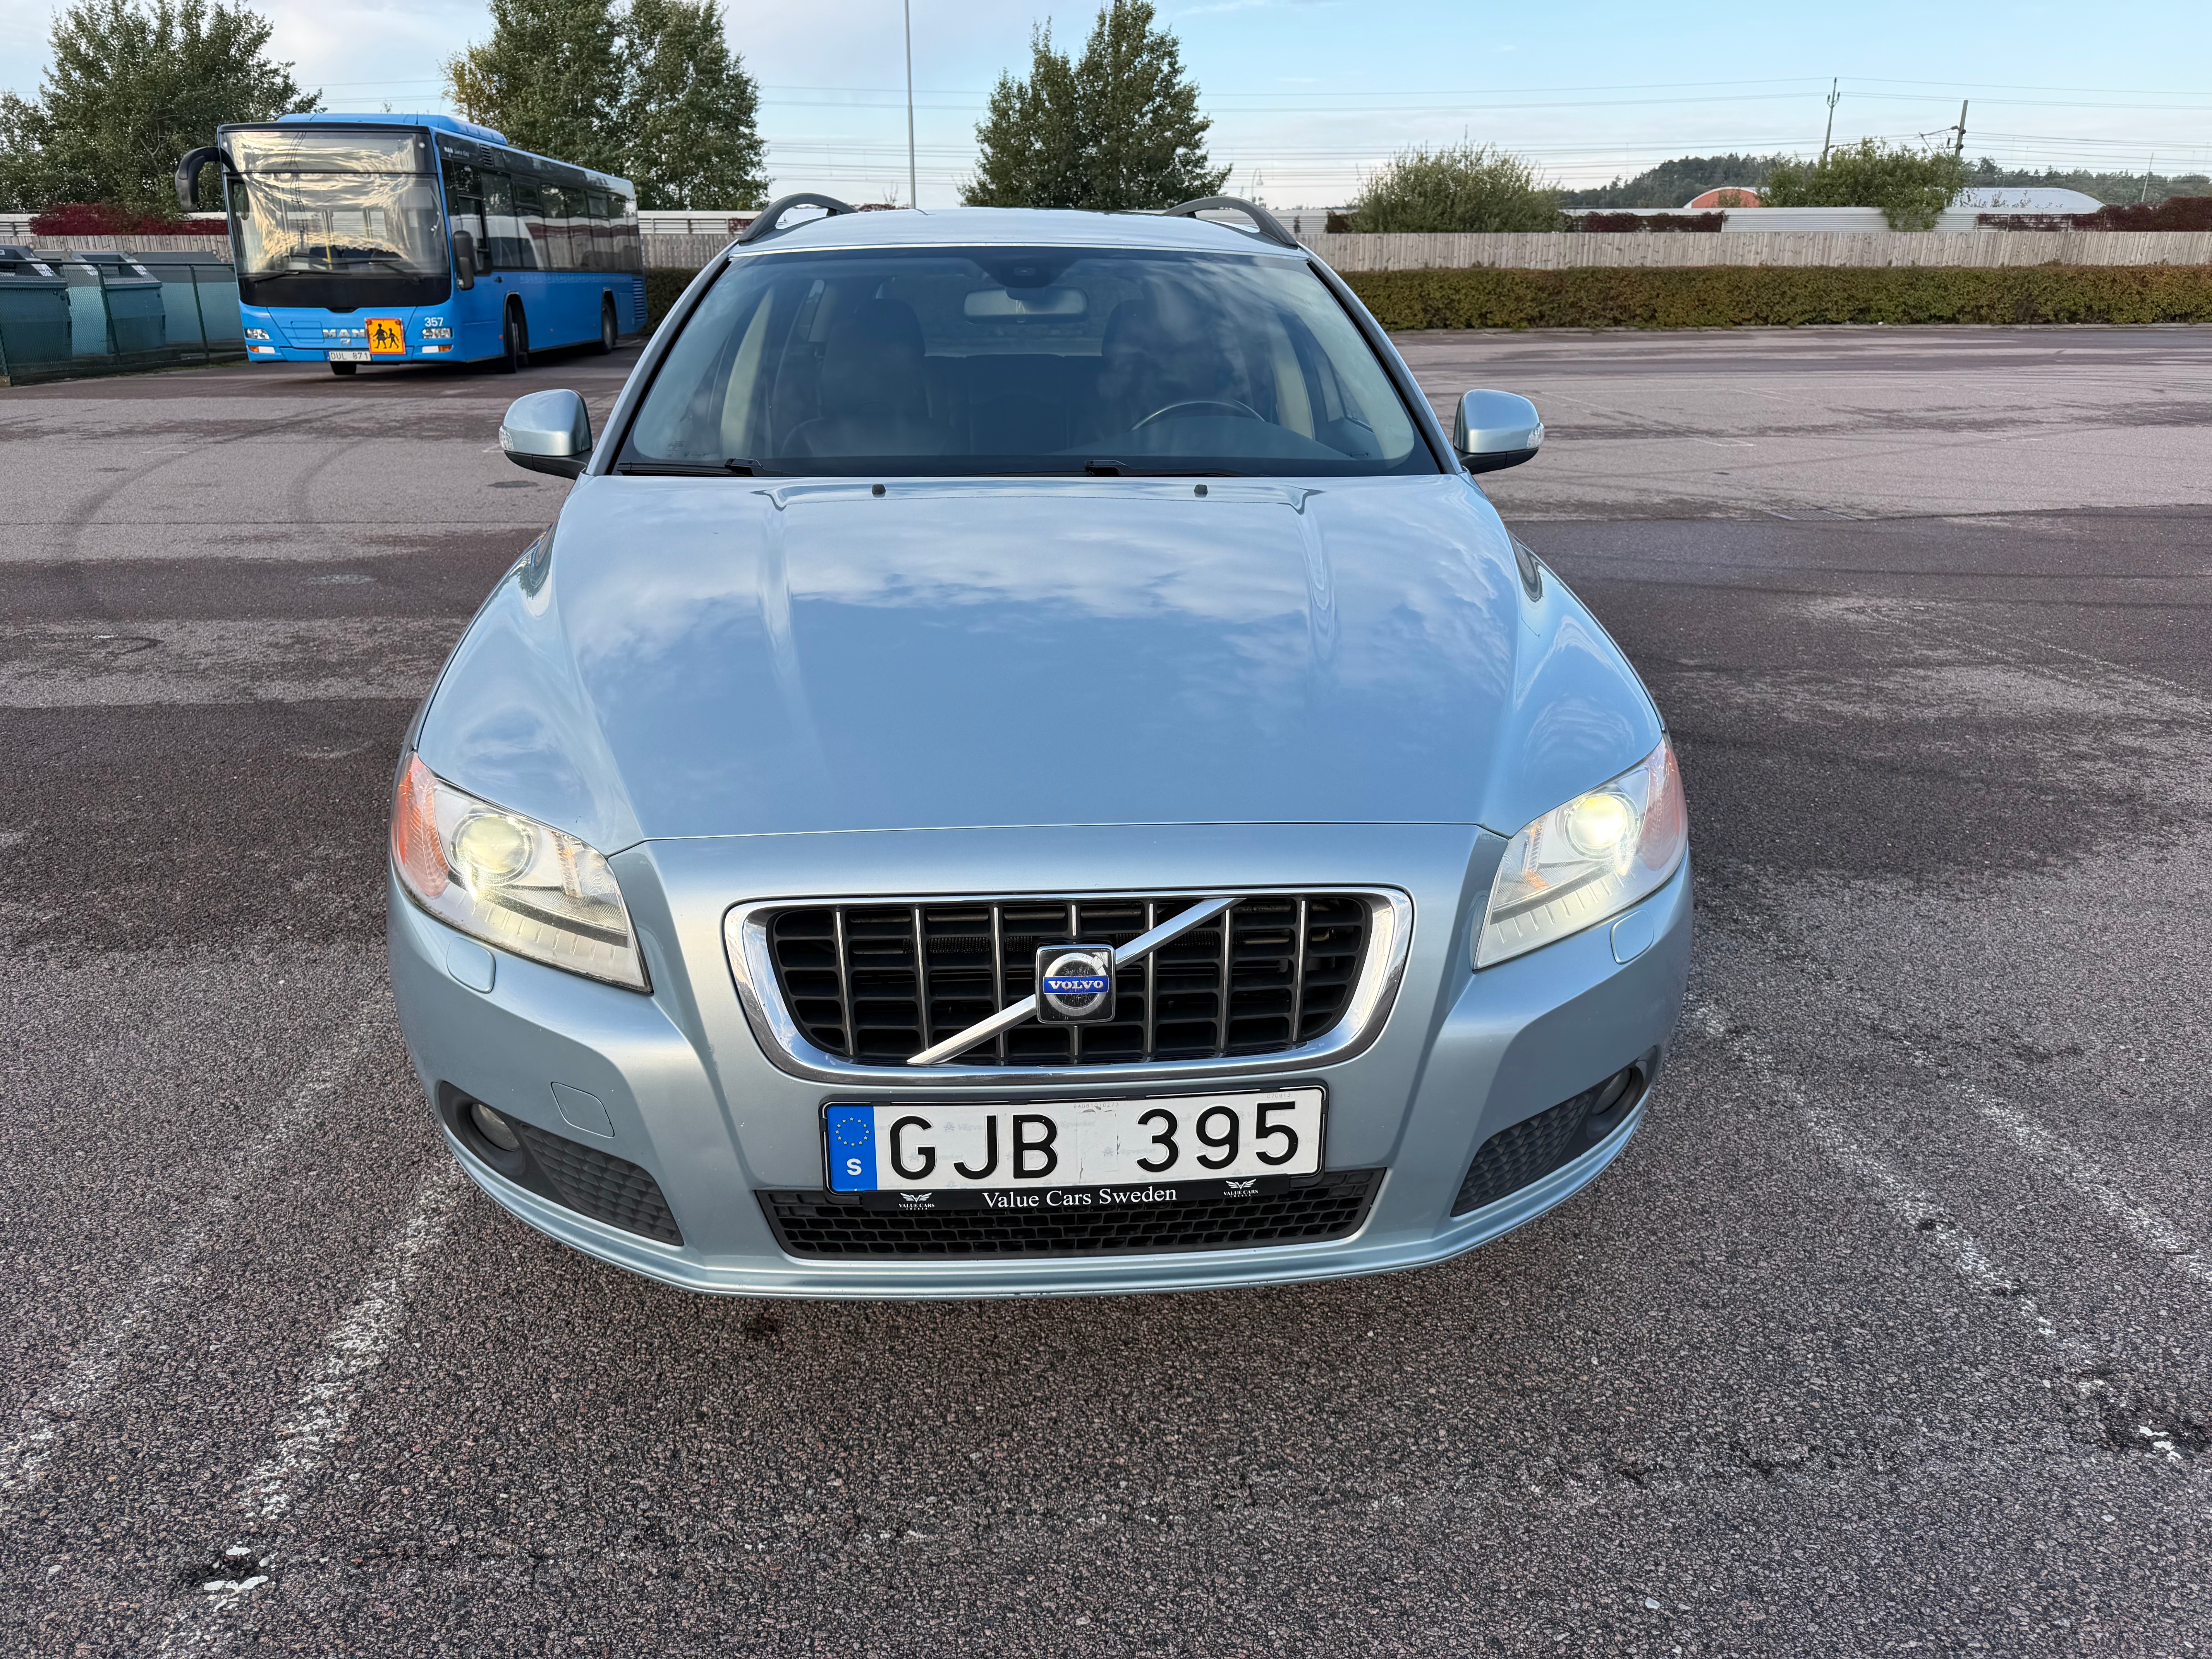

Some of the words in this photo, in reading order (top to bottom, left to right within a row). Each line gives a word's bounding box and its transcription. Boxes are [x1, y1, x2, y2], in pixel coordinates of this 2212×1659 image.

[424, 317, 443, 326] 357
[323, 329, 365, 338] MAN
[1048, 981, 1104, 989] VOLVO
[890, 1114, 1058, 1180] GJB
[1136, 1101, 1298, 1172] 395
[847, 1158, 862, 1175] S
[982, 1192, 1039, 1208] Value
[1046, 1190, 1091, 1206] Cars
[1099, 1186, 1177, 1204] Sweden
